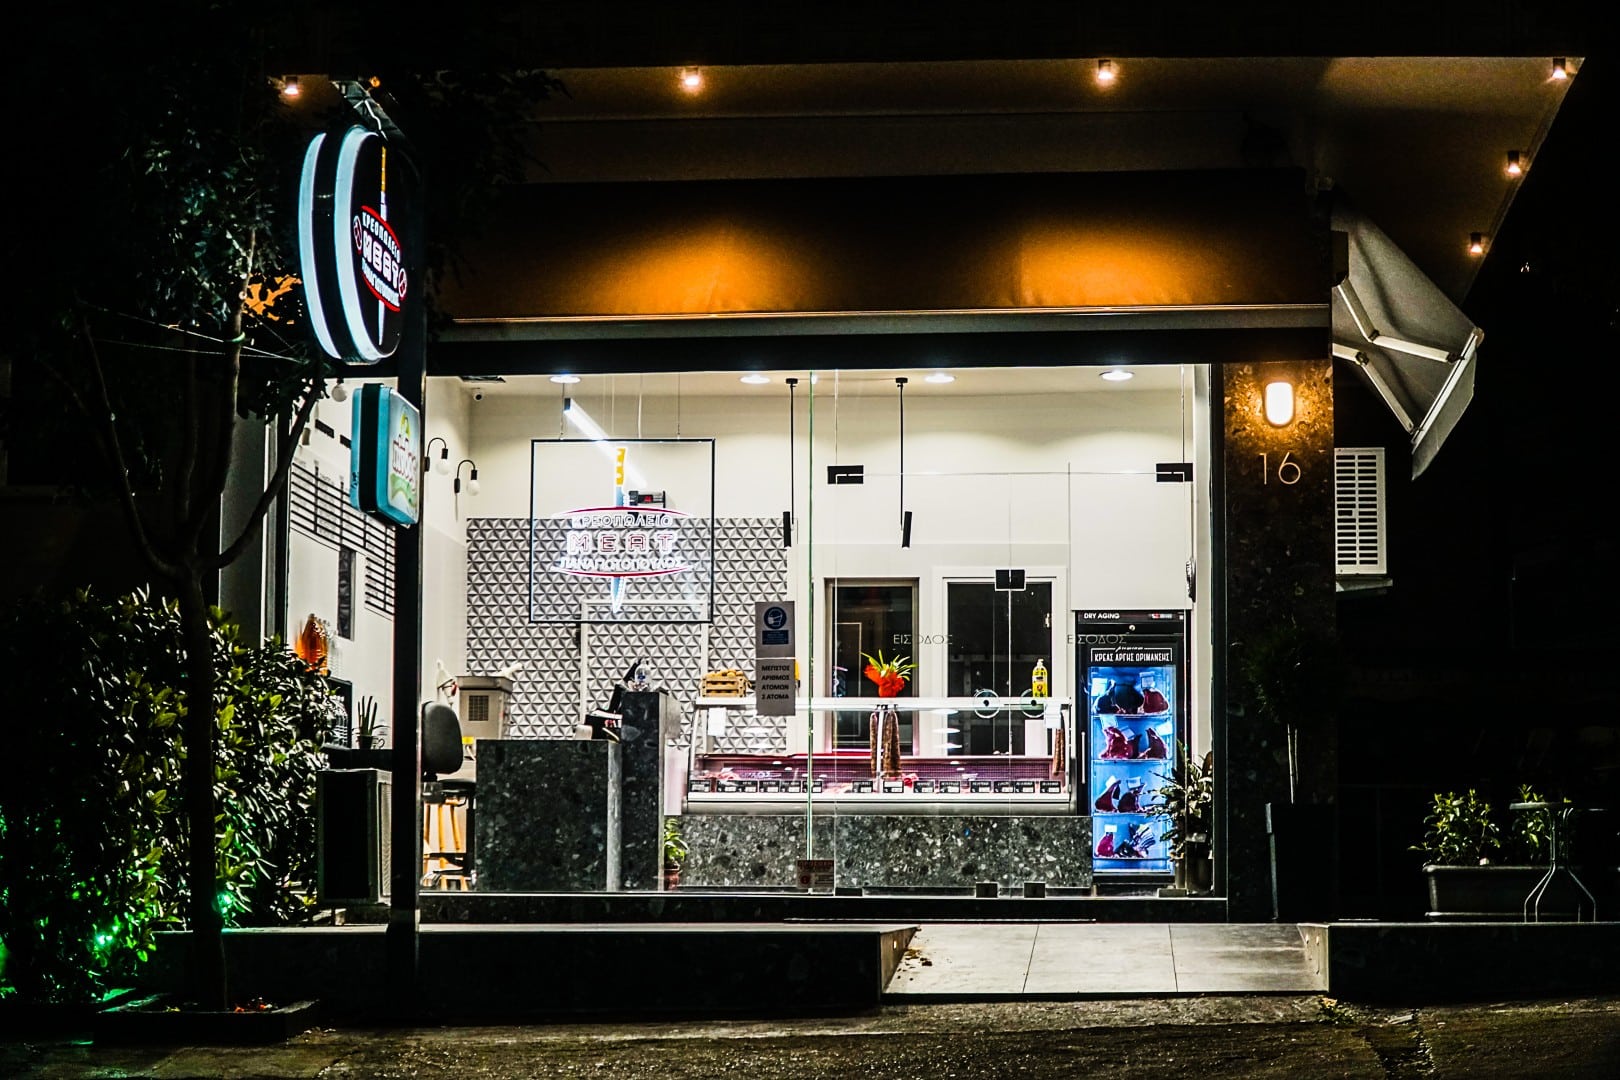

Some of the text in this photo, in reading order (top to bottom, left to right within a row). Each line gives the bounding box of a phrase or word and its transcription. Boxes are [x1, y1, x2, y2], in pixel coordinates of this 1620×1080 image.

[1259, 451, 1301, 485] 16
[571, 514, 674, 529] ΚΡΕΟΠΩΛΕΙΟ
[567, 531, 678, 556] MEAT
[1067, 634, 1127, 645] ΕΣΟΔΟΣ
[1094, 652, 1114, 662] ΚΡΕΑΣ
